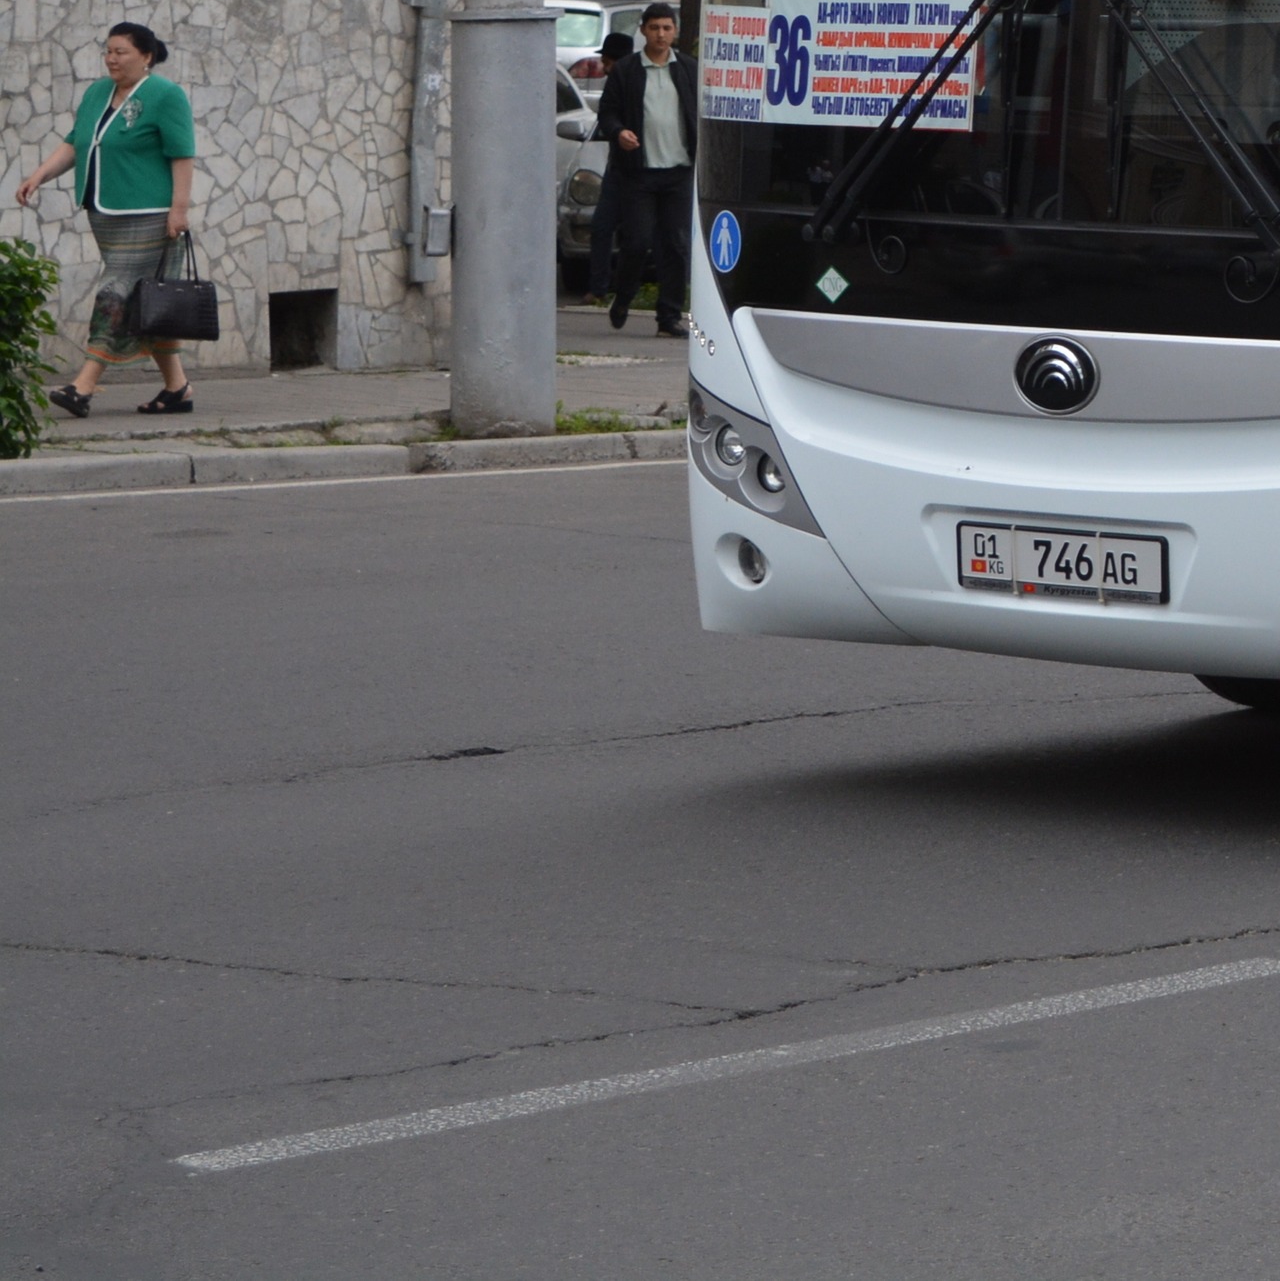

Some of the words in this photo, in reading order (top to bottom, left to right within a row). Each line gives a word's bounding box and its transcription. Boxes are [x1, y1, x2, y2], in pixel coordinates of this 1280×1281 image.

[915, 3, 950, 25] ГАГАРИН
[766, 14, 812, 106] 36
[973, 532, 1000, 559] 01
[1033, 538, 1094, 582] 746
[1102, 550, 1138, 586] AG
[988, 559, 1005, 575] KG
[1043, 584, 1098, 598] Kyrgyzstan
